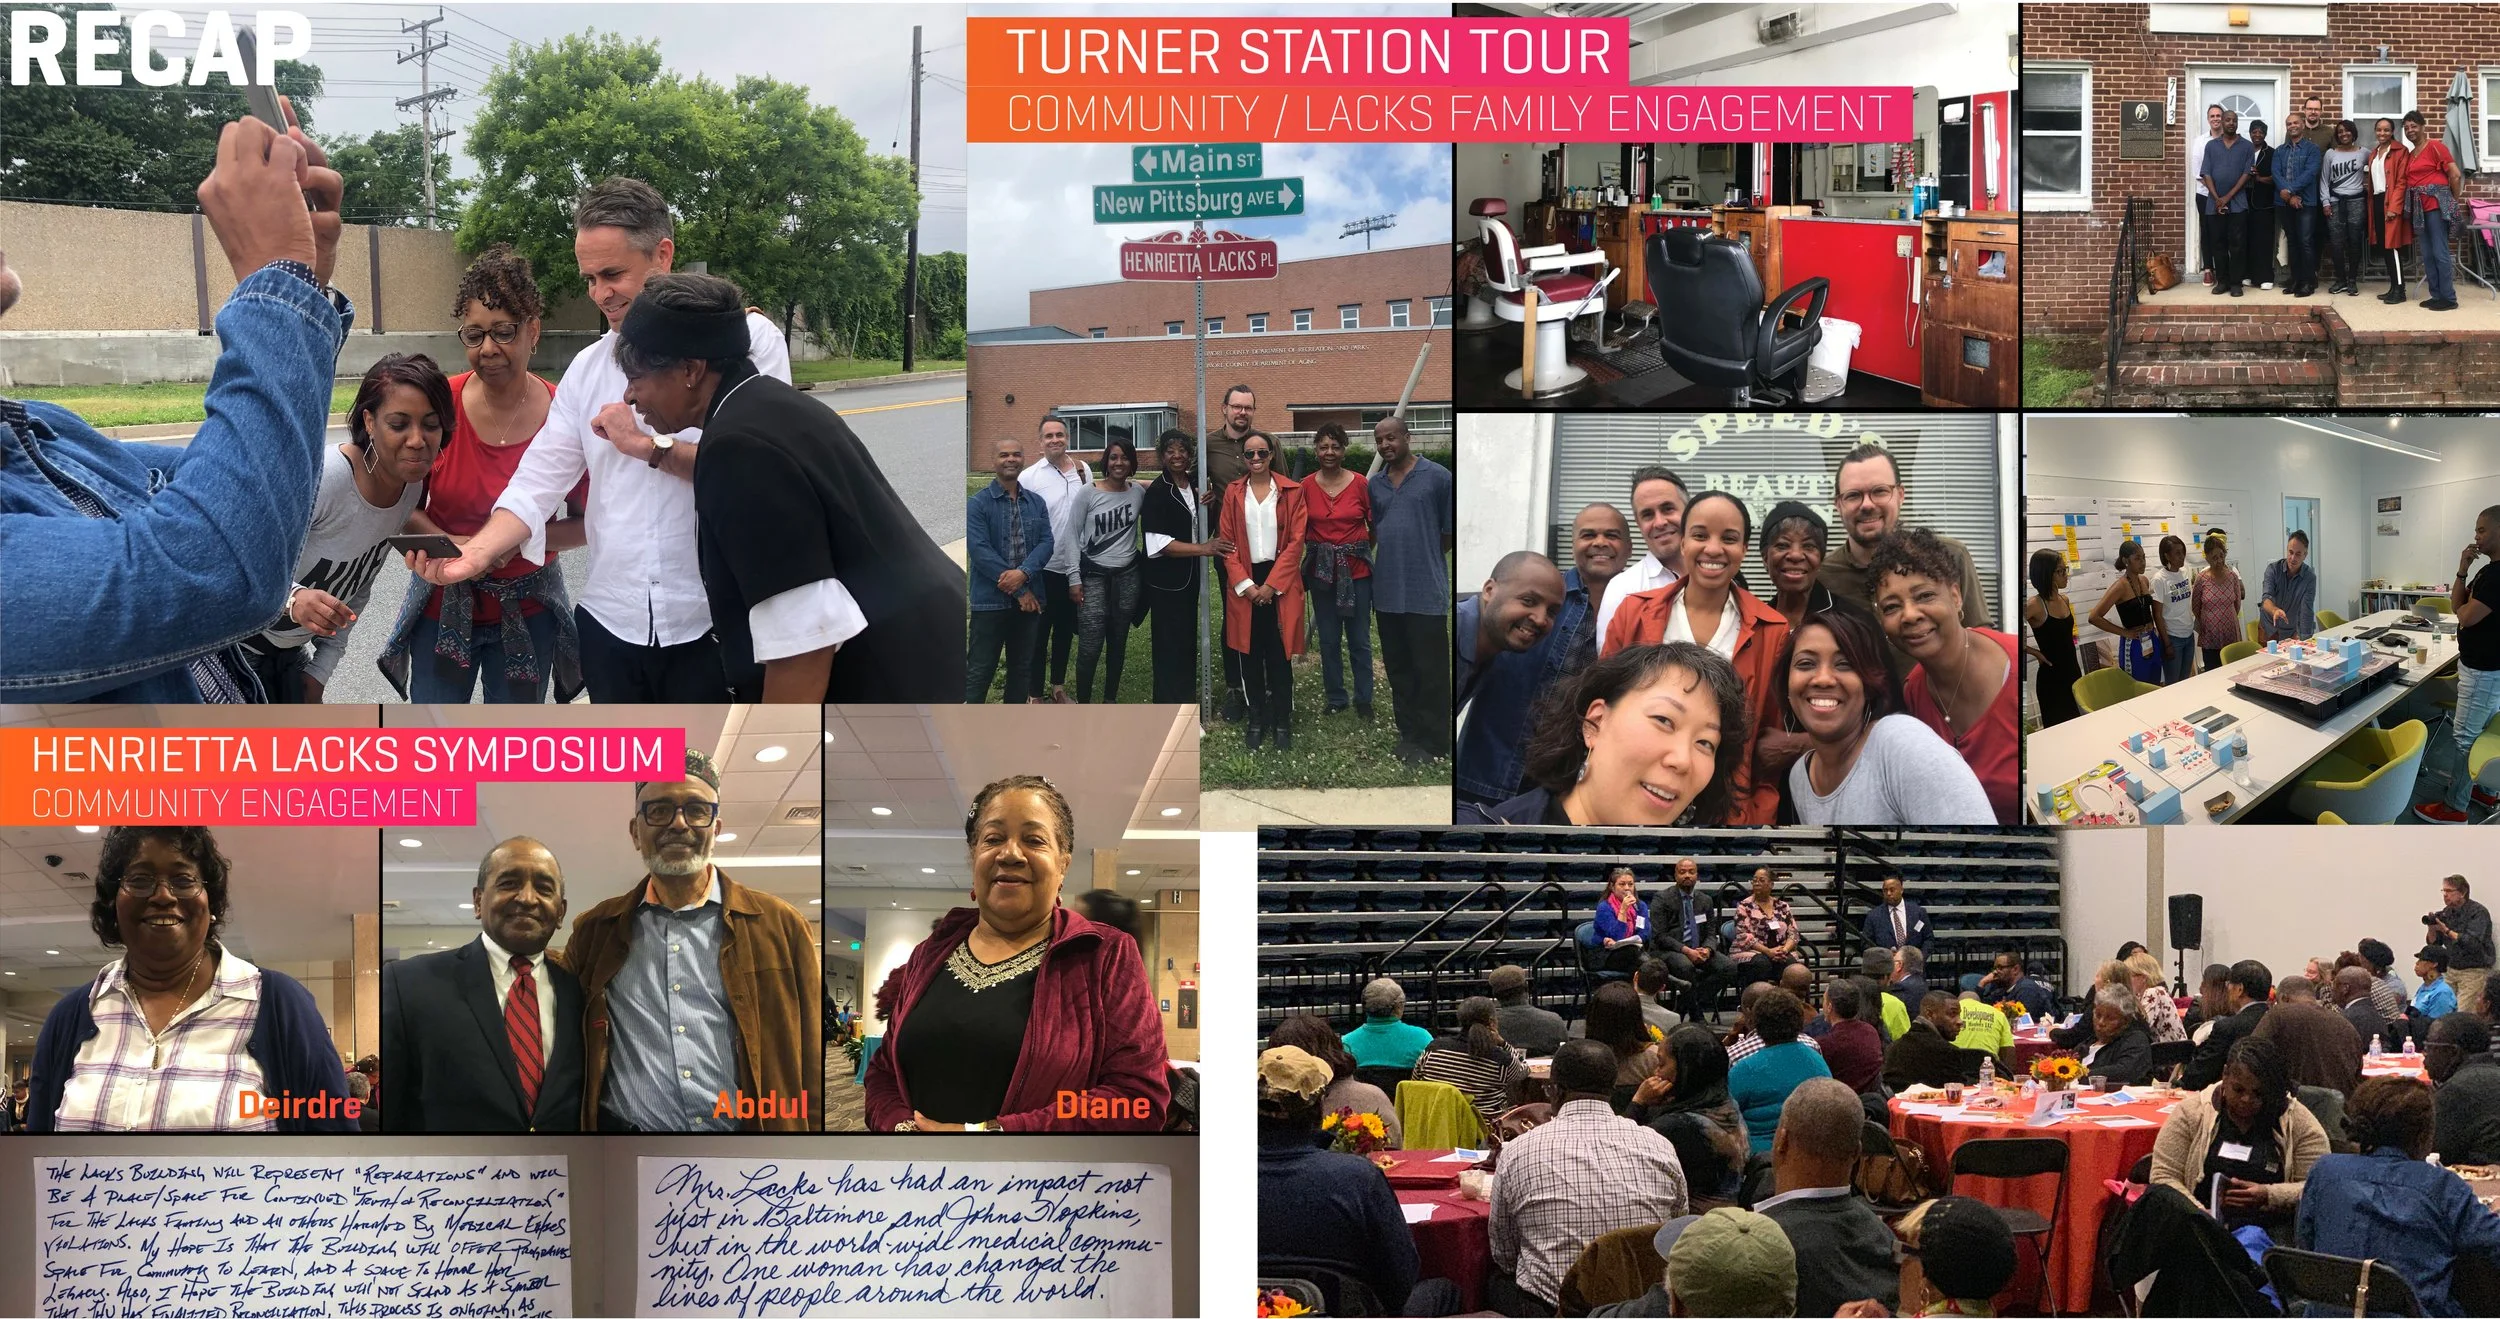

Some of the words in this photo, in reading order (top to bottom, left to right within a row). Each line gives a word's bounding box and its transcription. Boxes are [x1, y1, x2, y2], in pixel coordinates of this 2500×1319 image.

[1161, 149, 1232, 174] Main
[1236, 153, 1256, 168] ST
[2332, 159, 2357, 179] NIKE
[1101, 191, 1144, 215] New
[1150, 187, 1243, 215] Pittsburg
[1247, 191, 1275, 206] AVE
[1124, 251, 1202, 274] HENRIETTA
[1209, 250, 1257, 273] LACKS
[1261, 253, 1274, 268] PL
[1095, 504, 1132, 536] NIKE
[730, 1164, 823, 1209] Lacks
[828, 1163, 885, 1195] has
[891, 1163, 946, 1192] had
[949, 1174, 994, 1192] an
[997, 1170, 1103, 1200] impact
[1095, 1171, 1154, 1194] not
[655, 1202, 716, 1245] just
[716, 1202, 749, 1229] in
[753, 1196, 888, 1228] Baltimore
[890, 1202, 949, 1231] and
[946, 1195, 1025, 1243] Johns
[723, 1253, 782, 1284] One
[787, 1261, 888, 1278] woman
[895, 1252, 952, 1277] has
[955, 1252, 1065, 1294] changed
[1070, 1250, 1120, 1274] the
